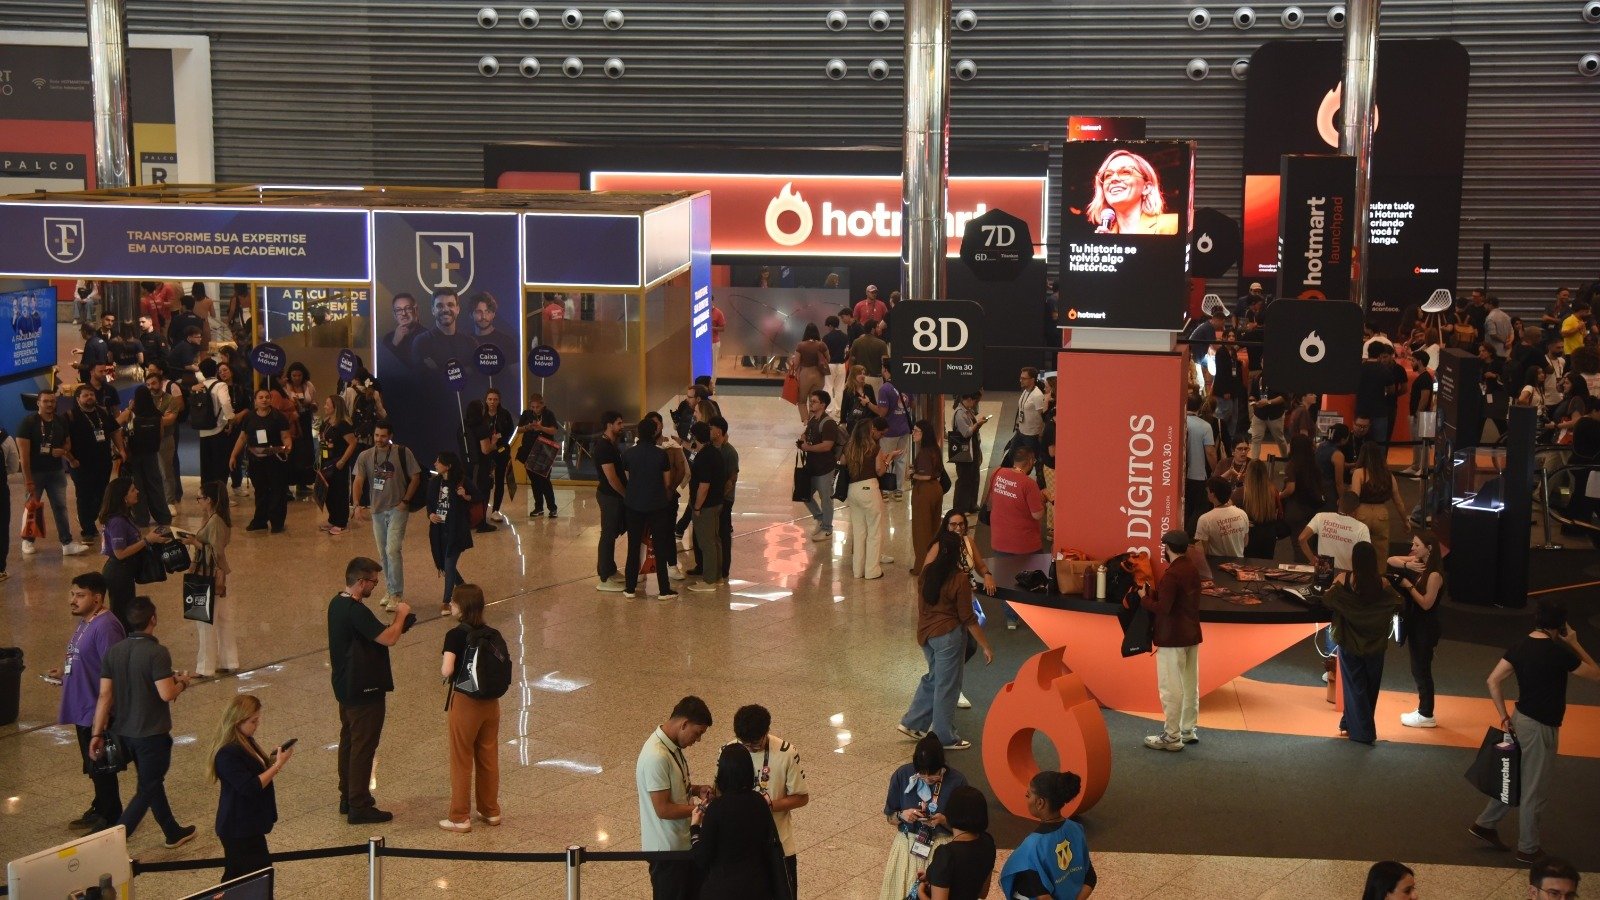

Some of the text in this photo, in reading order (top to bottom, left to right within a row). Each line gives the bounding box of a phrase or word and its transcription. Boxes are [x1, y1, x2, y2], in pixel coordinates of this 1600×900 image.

[4, 160, 74, 171] PALCO
[151, 167, 168, 184] R
[1393, 201, 1415, 210] tudo
[822, 201, 987, 237] hotr
[1375, 210, 1413, 219] Hotmart
[1370, 219, 1404, 227] criando
[981, 225, 1016, 247] 7D
[1328, 196, 1344, 264] launchpad
[1370, 227, 1400, 236] você ir
[127, 230, 307, 244] TRANSFORME SUA EXPERTISE
[1303, 196, 1326, 286] hotmart
[1371, 236, 1399, 245] longe.
[127, 243, 307, 256] EM AUTORIDADE ACADÊMICA
[1069, 244, 1137, 254] Tu historia se
[974, 253, 988, 261] 6D
[1069, 253, 1124, 265] volvió algo
[430, 241, 464, 287] F
[1069, 261, 1118, 272] histórico.
[282, 289, 292, 299] A
[1077, 311, 1106, 319] hotmart
[912, 316, 969, 352] 8D
[258, 351, 279, 361] Caixa
[902, 362, 921, 374] 7D
[1163, 443, 1172, 457] 30
[1119, 414, 1155, 539] DÍGITOS
[1162, 458, 1172, 486] NOVA
[1500, 757, 1511, 804] Manychat
